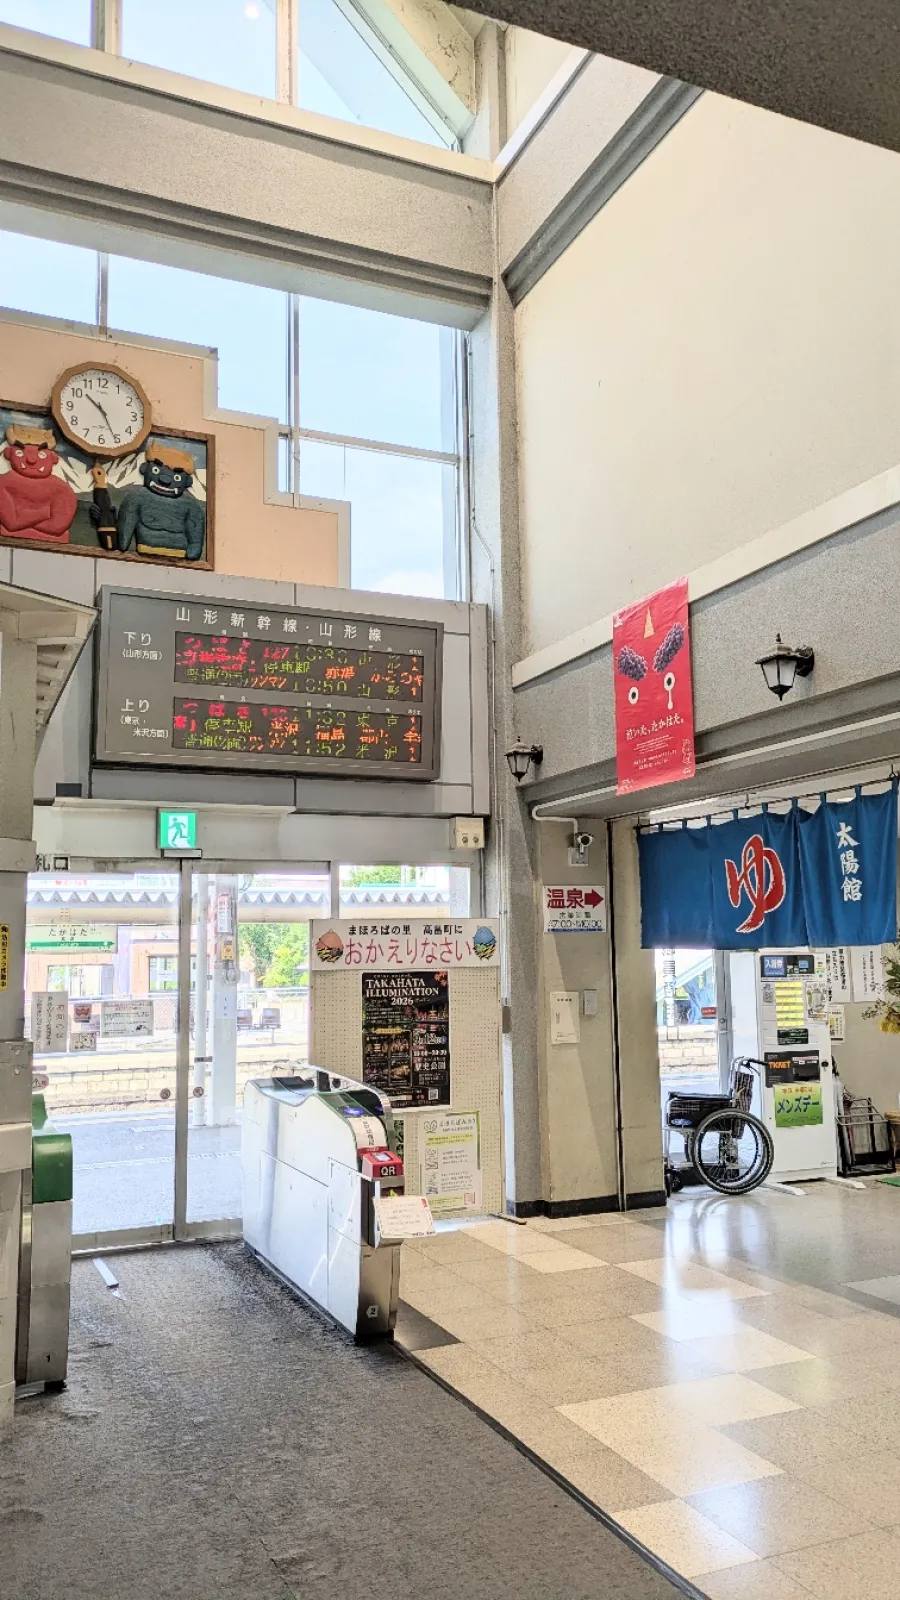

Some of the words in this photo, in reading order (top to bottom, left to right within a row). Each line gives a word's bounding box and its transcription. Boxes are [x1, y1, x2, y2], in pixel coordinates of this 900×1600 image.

[83, 379, 93, 390] 11
[97, 378, 109, 389] 12
[71, 387, 83, 399] 10
[116, 384, 121, 395] 1
[66, 401, 74, 411] 9
[125, 396, 133, 407] 2
[70, 415, 78, 426] 8
[130, 411, 138, 422] 3
[82, 428, 90, 438] 7
[124, 425, 133, 436] 4
[98, 434, 106, 445] 6
[114, 434, 121, 444] 5
[123, 631, 152, 646] 下り
[120, 698, 150, 713] 上り
[836, 822, 863, 902] 太陽館
[724, 833, 787, 934] ゆ
[547, 887, 585, 909] 温泉
[348, 924, 412, 936] まほろばの里
[344, 938, 472, 965] おかえりなさい
[365, 978, 426, 989] TAKAHATA
[366, 987, 440, 998] ILLUMINATION
[391, 997, 414, 1006] 2026
[776, 1094, 820, 1114] メンズデー
[380, 1166, 396, 1176] QR
[370, 1307, 376, 1315] 2
